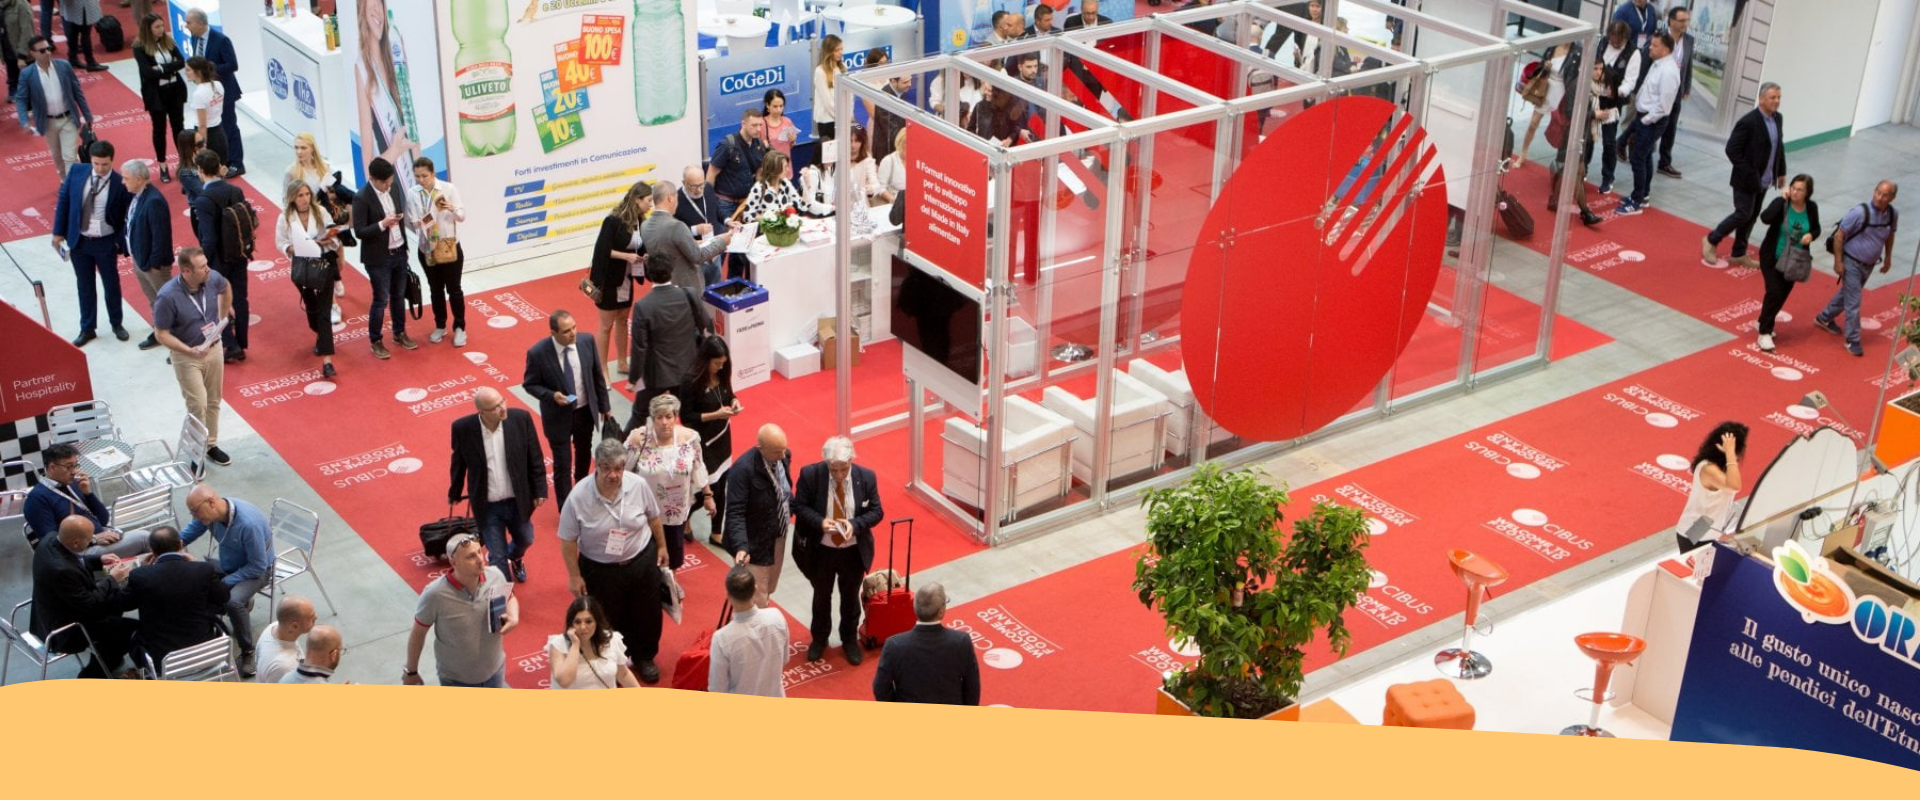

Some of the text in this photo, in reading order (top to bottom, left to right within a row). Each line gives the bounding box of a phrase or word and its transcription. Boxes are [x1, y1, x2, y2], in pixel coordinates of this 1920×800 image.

[465, 82, 506, 97] ULIVETO
[722, 66, 784, 93] CoGeDi
[514, 145, 648, 177] Forti investimenti in Comunicazione
[514, 184, 524, 194] TV
[921, 162, 944, 180] Format
[944, 174, 976, 197] innovativo
[924, 179, 934, 189] per
[942, 188, 968, 207] sviluppo
[924, 190, 966, 220] internazionale
[514, 201, 533, 210] Radio
[514, 216, 539, 226] Stampa
[930, 208, 948, 224] Made
[948, 218, 956, 228] in
[956, 222, 970, 238] Italy
[516, 230, 538, 242] Digital
[928, 222, 960, 246] alimentare
[14, 374, 56, 390] Partner
[16, 382, 76, 402] Hospitality
[428, 375, 477, 392] CIBUS
[252, 390, 304, 408] CIBUS
[408, 390, 470, 410] WELCOME
[1603, 393, 1648, 414] CIBUS
[1817, 416, 1866, 440] CIBUS
[320, 444, 404, 472] FOODLAND
[344, 448, 410, 470] WELCOME
[1464, 441, 1510, 464] CIBUS
[334, 468, 388, 488] CIBUS
[1335, 487, 1351, 498] TO
[1344, 484, 1414, 524] FOODLAND
[1350, 495, 1405, 526] WELCOME
[1487, 520, 1564, 560] FOODLAND
[1496, 517, 1570, 557] WELCOME TO
[1542, 523, 1594, 550] CIBUS
[1382, 585, 1434, 614] CIBUS
[1390, 610, 1408, 622] TO
[977, 610, 1045, 659] WELCOME TO
[988, 608, 1055, 656] FOODLAND
[1854, 599, 1920, 661] OR
[1148, 646, 1183, 669] WELC
[1742, 616, 1758, 640] Il
[1762, 634, 1812, 668] gusto
[1818, 661, 1871, 698] unico
[1730, 642, 1920, 756] alle pendici dell'Etn
